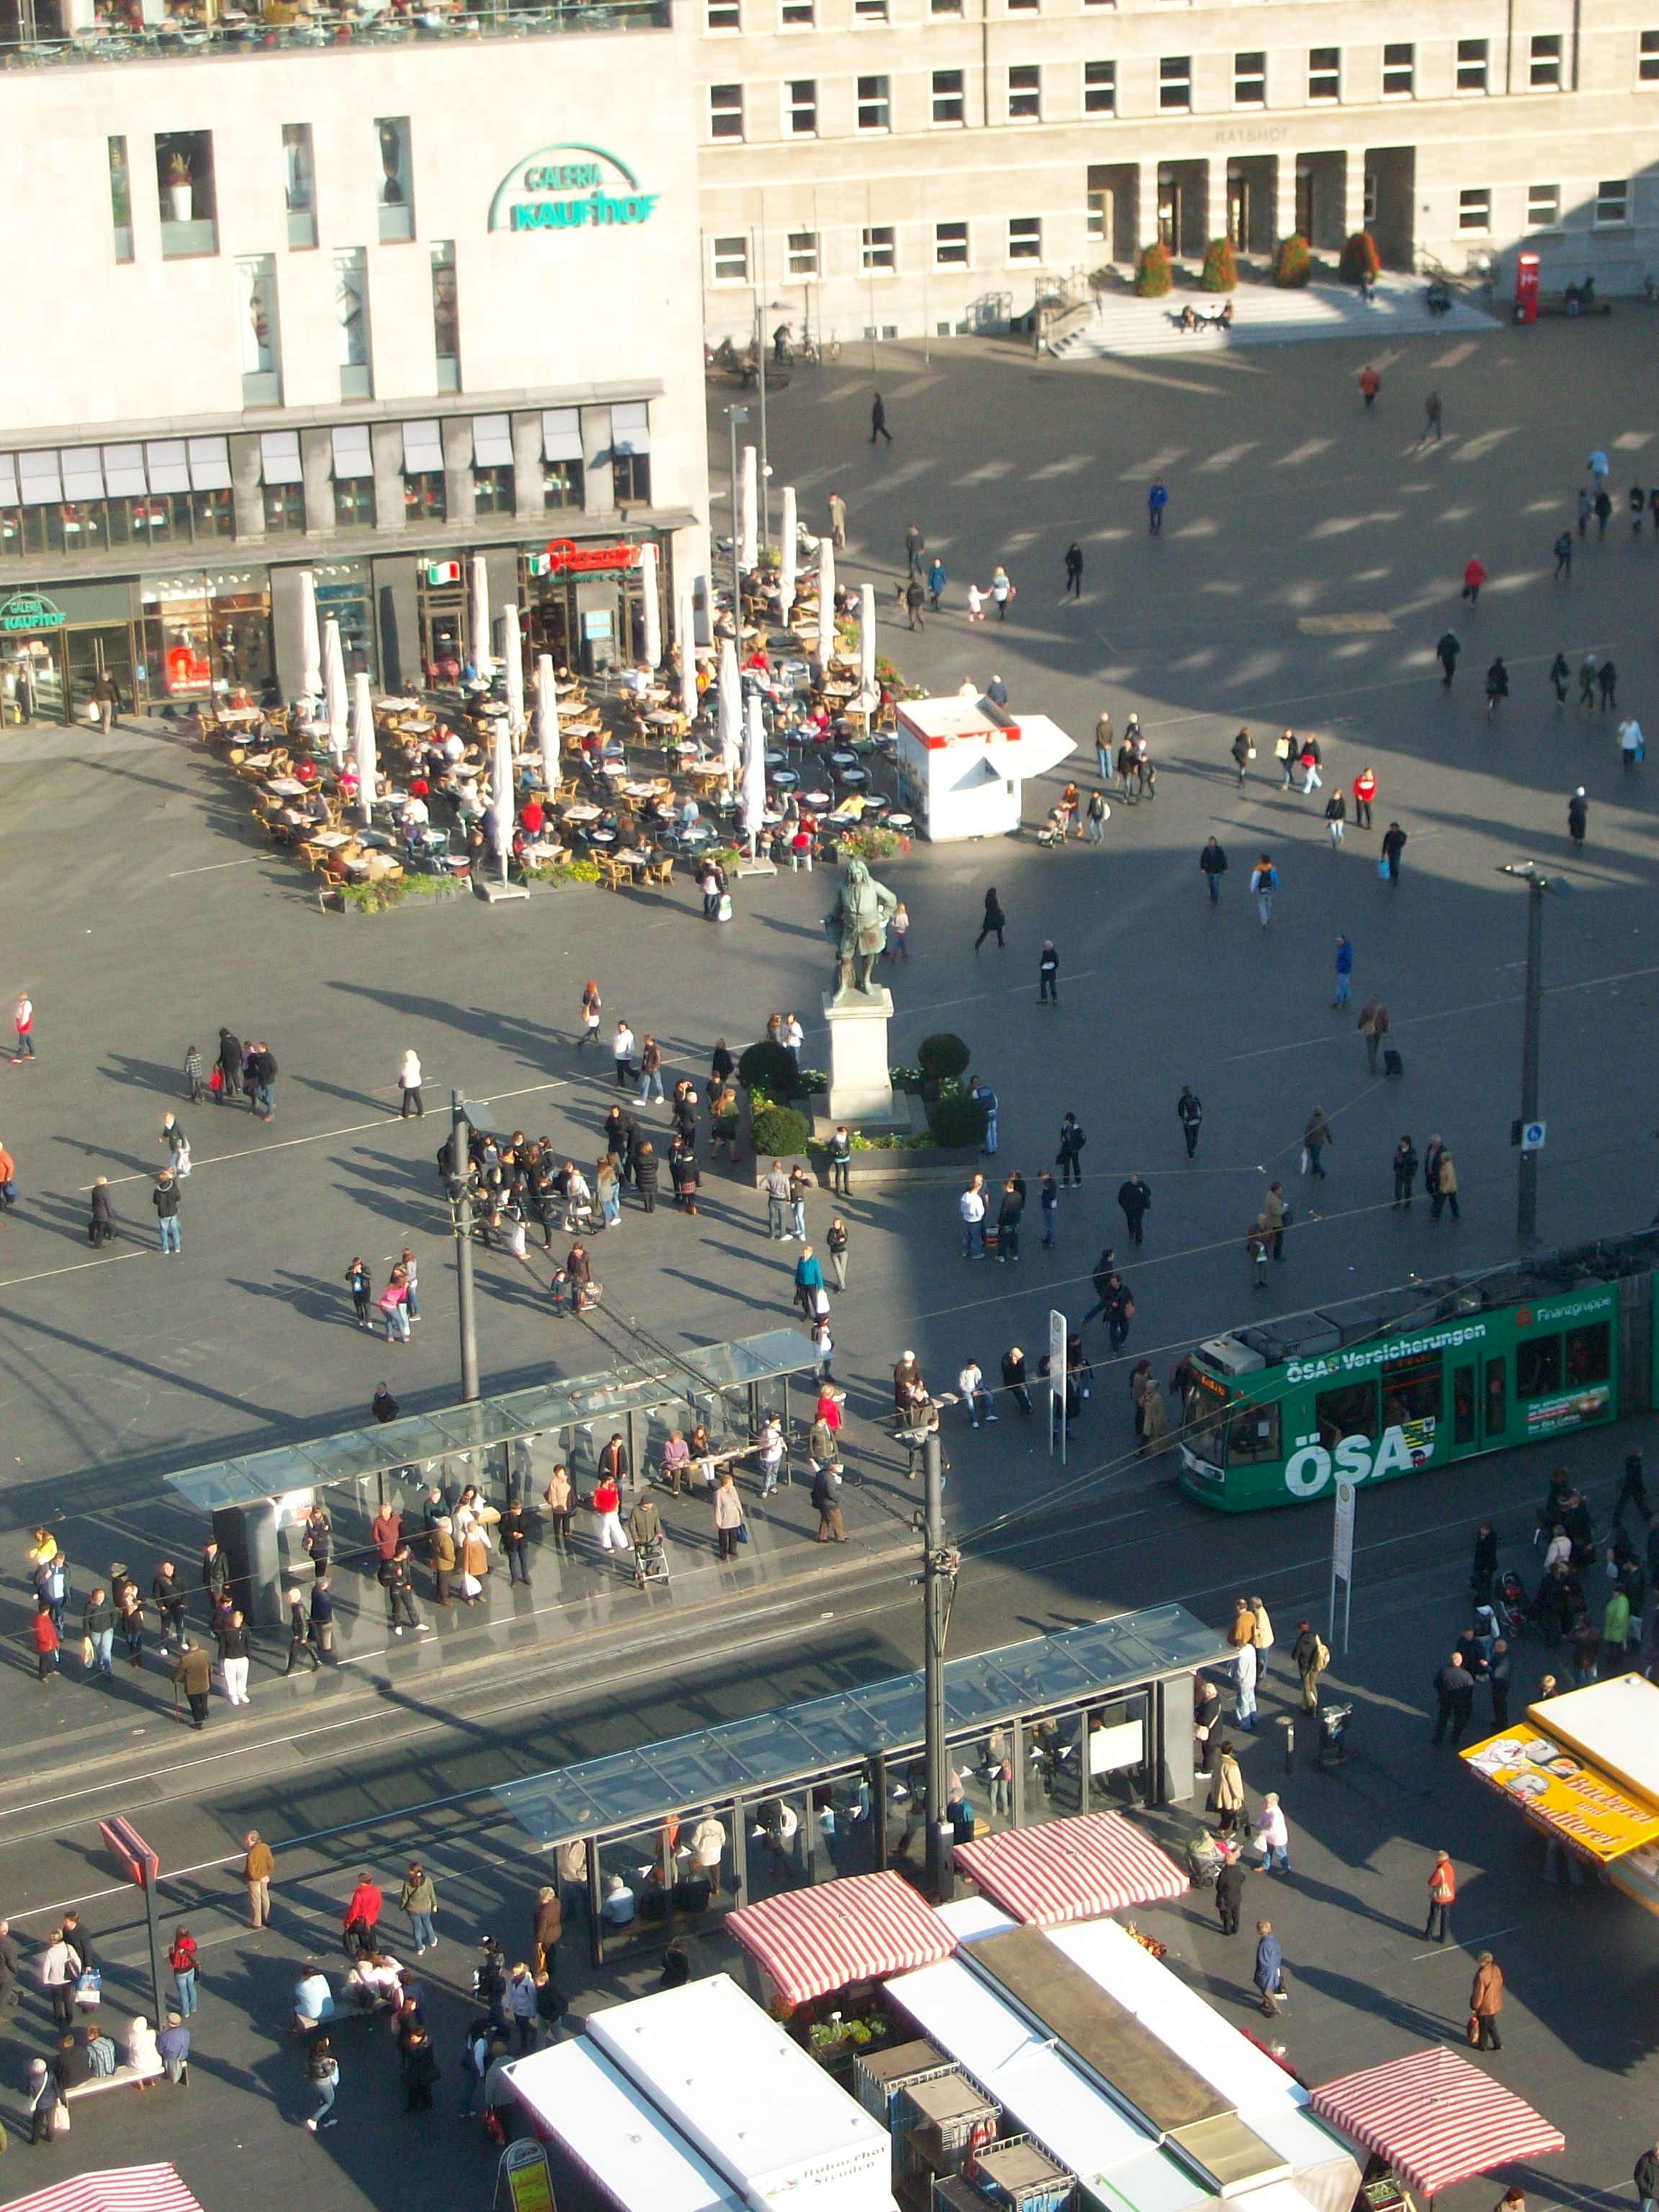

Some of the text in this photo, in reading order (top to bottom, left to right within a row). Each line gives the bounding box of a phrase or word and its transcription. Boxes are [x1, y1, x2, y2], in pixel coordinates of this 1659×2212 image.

[526, 163, 603, 192] GALERIA
[1537, 1296, 1611, 1322] Finanzgruppe
[1287, 1360, 1329, 1383] ÖSA
[1342, 1323, 1487, 1370] Versicherungen
[1285, 1424, 1414, 1496] ÖSA
[1575, 1802, 1609, 1817] und
